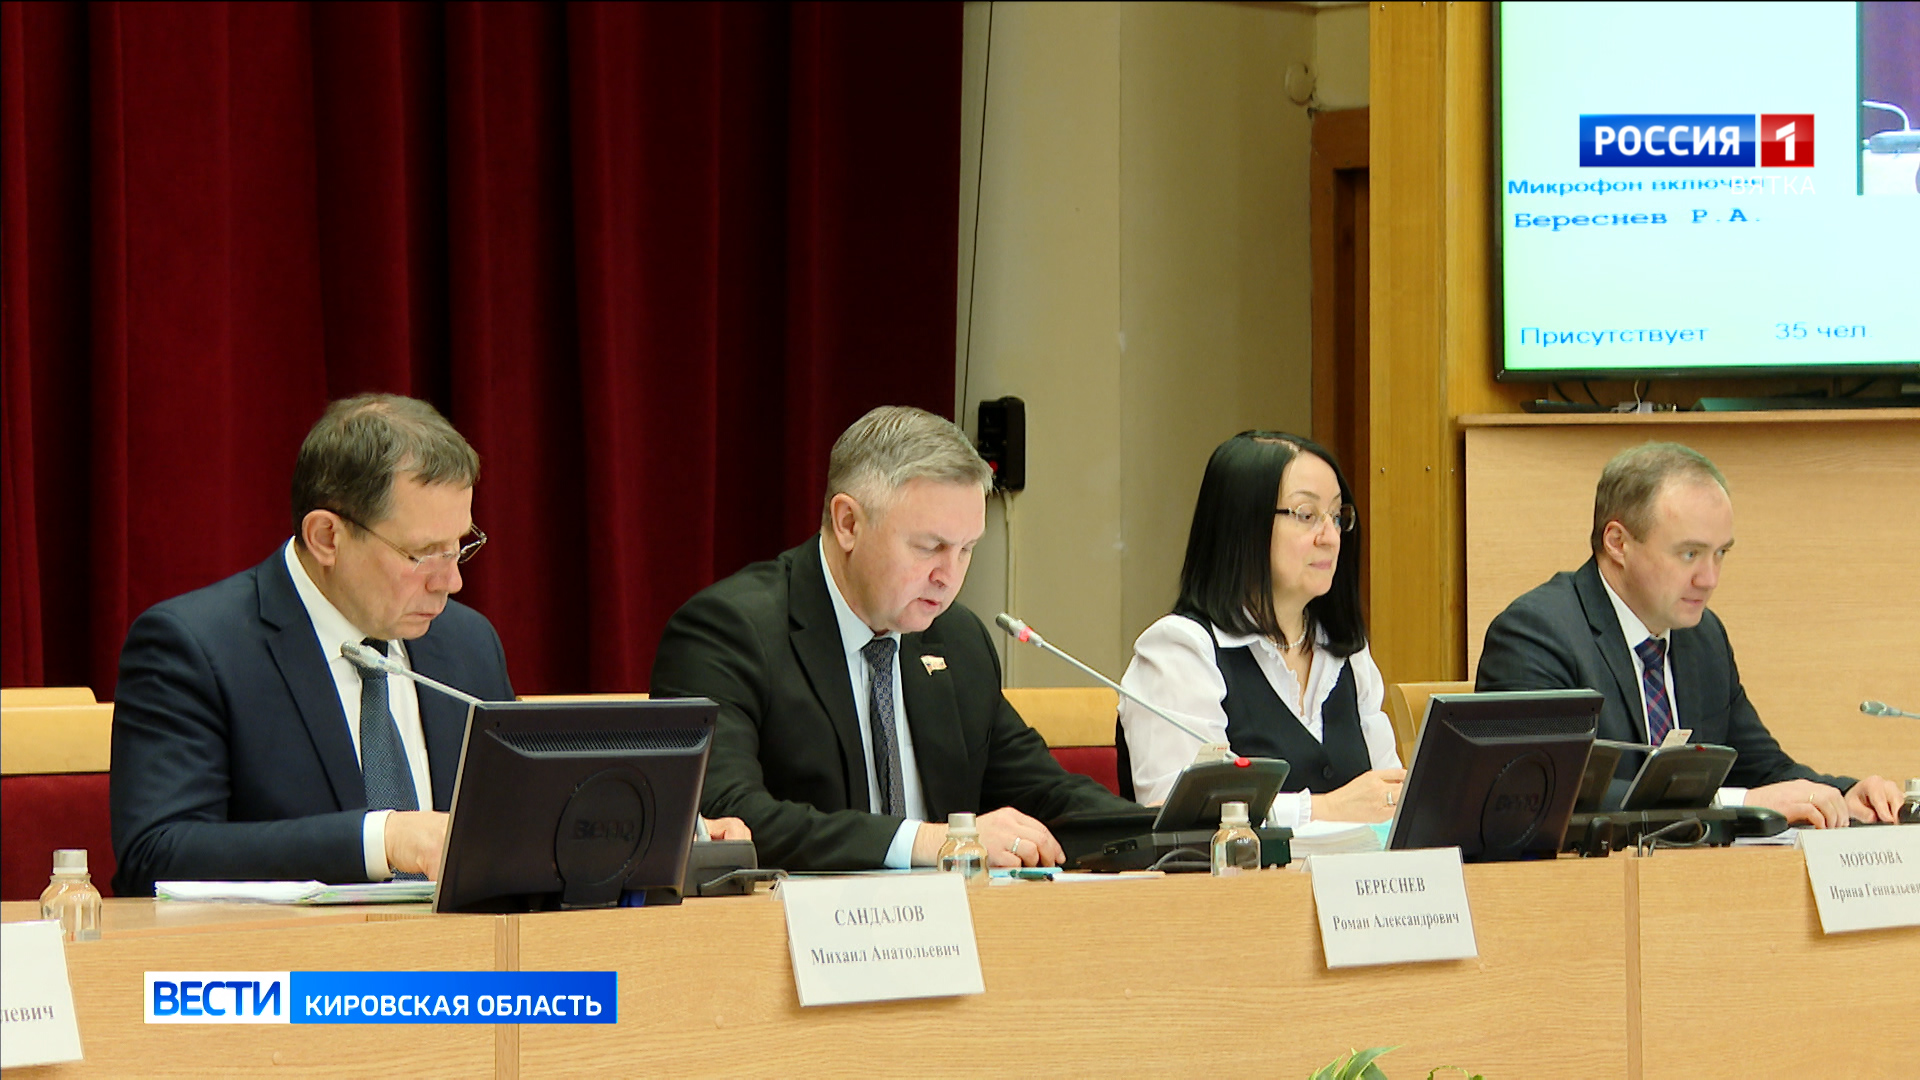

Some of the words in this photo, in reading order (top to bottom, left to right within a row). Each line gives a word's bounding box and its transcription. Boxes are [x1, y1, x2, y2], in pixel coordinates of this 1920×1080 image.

[1507, 178, 1643, 198] Микрофон
[1513, 212, 1669, 232] Береснев
[1520, 326, 1709, 348] Присутствует
[1775, 322, 1809, 341] 35
[1839, 850, 1904, 868] МОРОЗОВА
[1354, 876, 1427, 896] БЕРЕСНЕВ
[1829, 884, 1865, 904] Ирина
[834, 905, 925, 927] САНДАЛОВ
[1332, 914, 1370, 932] Роман
[1373, 911, 1460, 930] Александрович
[810, 947, 868, 965] Михаил
[871, 943, 961, 962] Анатольевич
